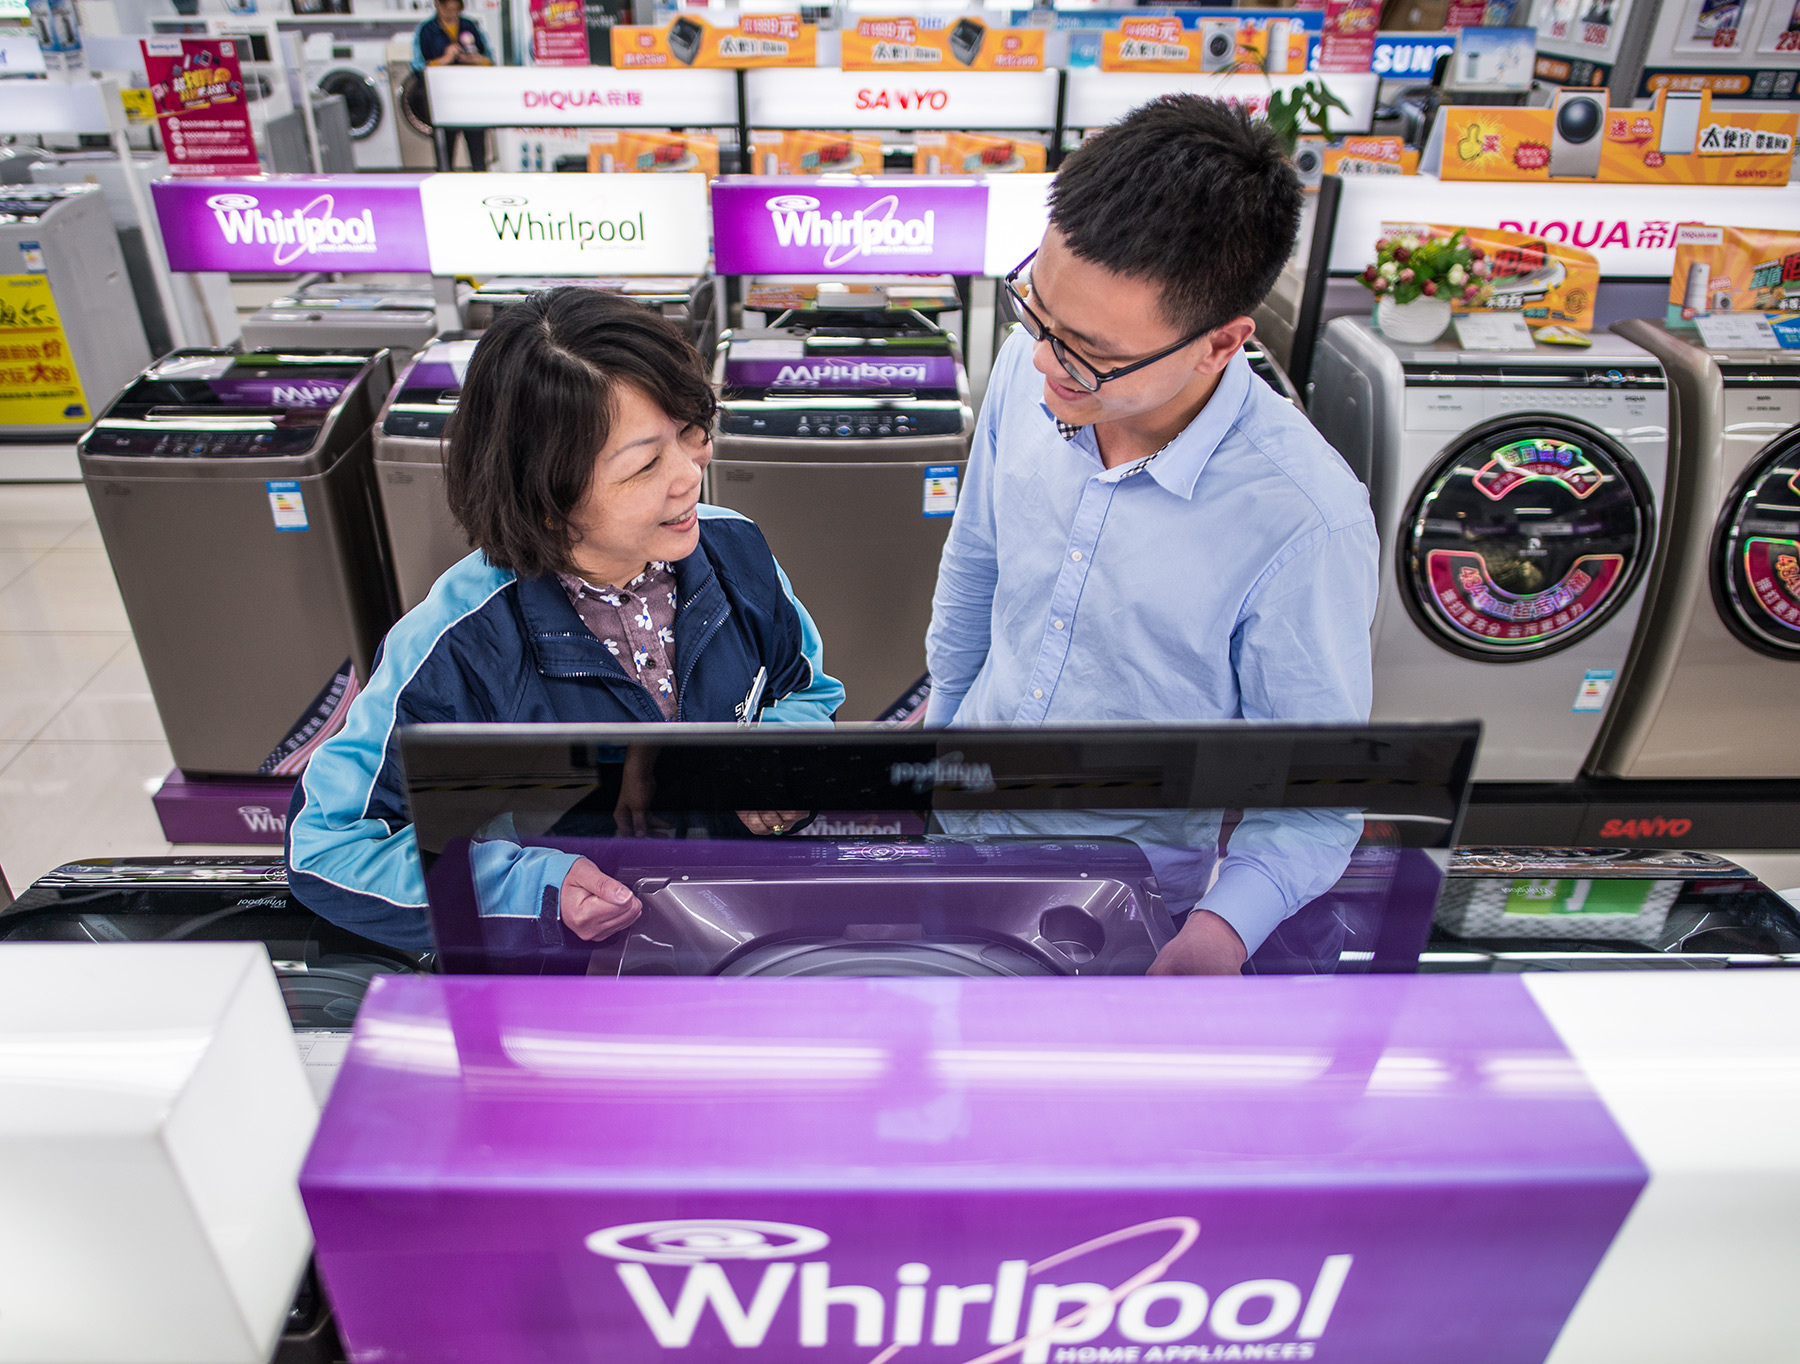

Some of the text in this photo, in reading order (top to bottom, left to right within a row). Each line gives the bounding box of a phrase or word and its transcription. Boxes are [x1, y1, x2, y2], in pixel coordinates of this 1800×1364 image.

[1712, 28, 1738, 48] 63
[1775, 31, 1800, 51] 23
[523, 90, 603, 109] DIQUA
[856, 88, 948, 111] SANYO
[213, 208, 376, 254] Whirlpool
[489, 211, 645, 250] Whirlpool
[771, 209, 935, 256] Whirlpool
[1599, 817, 1693, 839] SANYO
[236, 898, 287, 909] Whirlpool
[614, 1252, 1355, 1364] Whirlpool
[1054, 1342, 1317, 1364] HOME APPLIANCES
